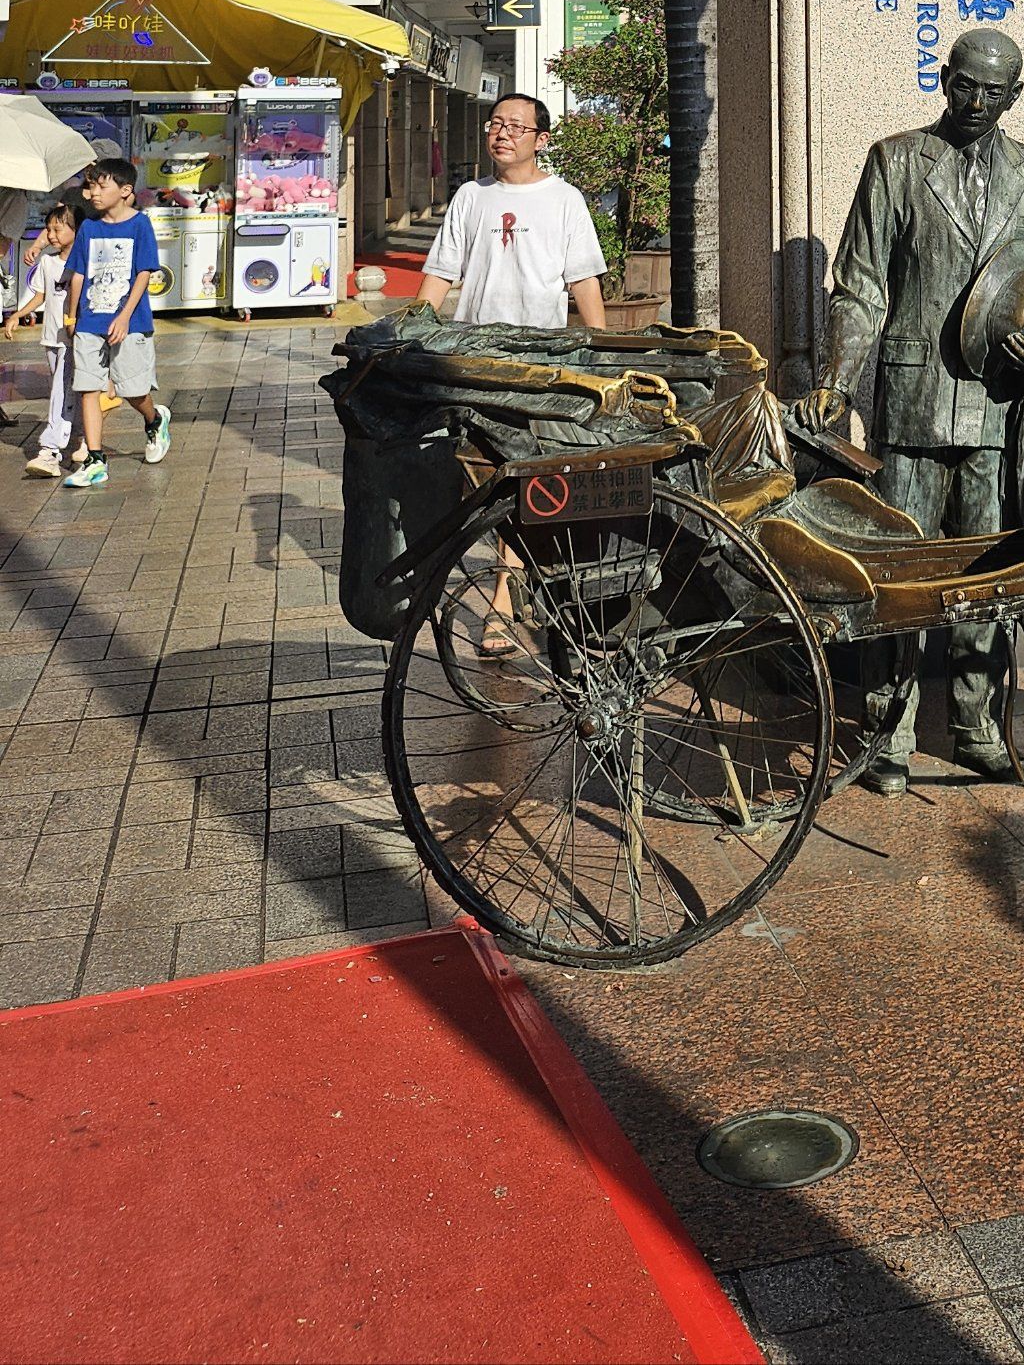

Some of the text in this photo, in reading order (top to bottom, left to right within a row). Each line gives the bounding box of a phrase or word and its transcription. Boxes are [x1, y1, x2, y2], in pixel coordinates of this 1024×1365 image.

[917, 2, 940, 93] ROAD
[573, 467, 644, 490] 仅供拍照
[573, 489, 645, 512] 禁止攀爬
